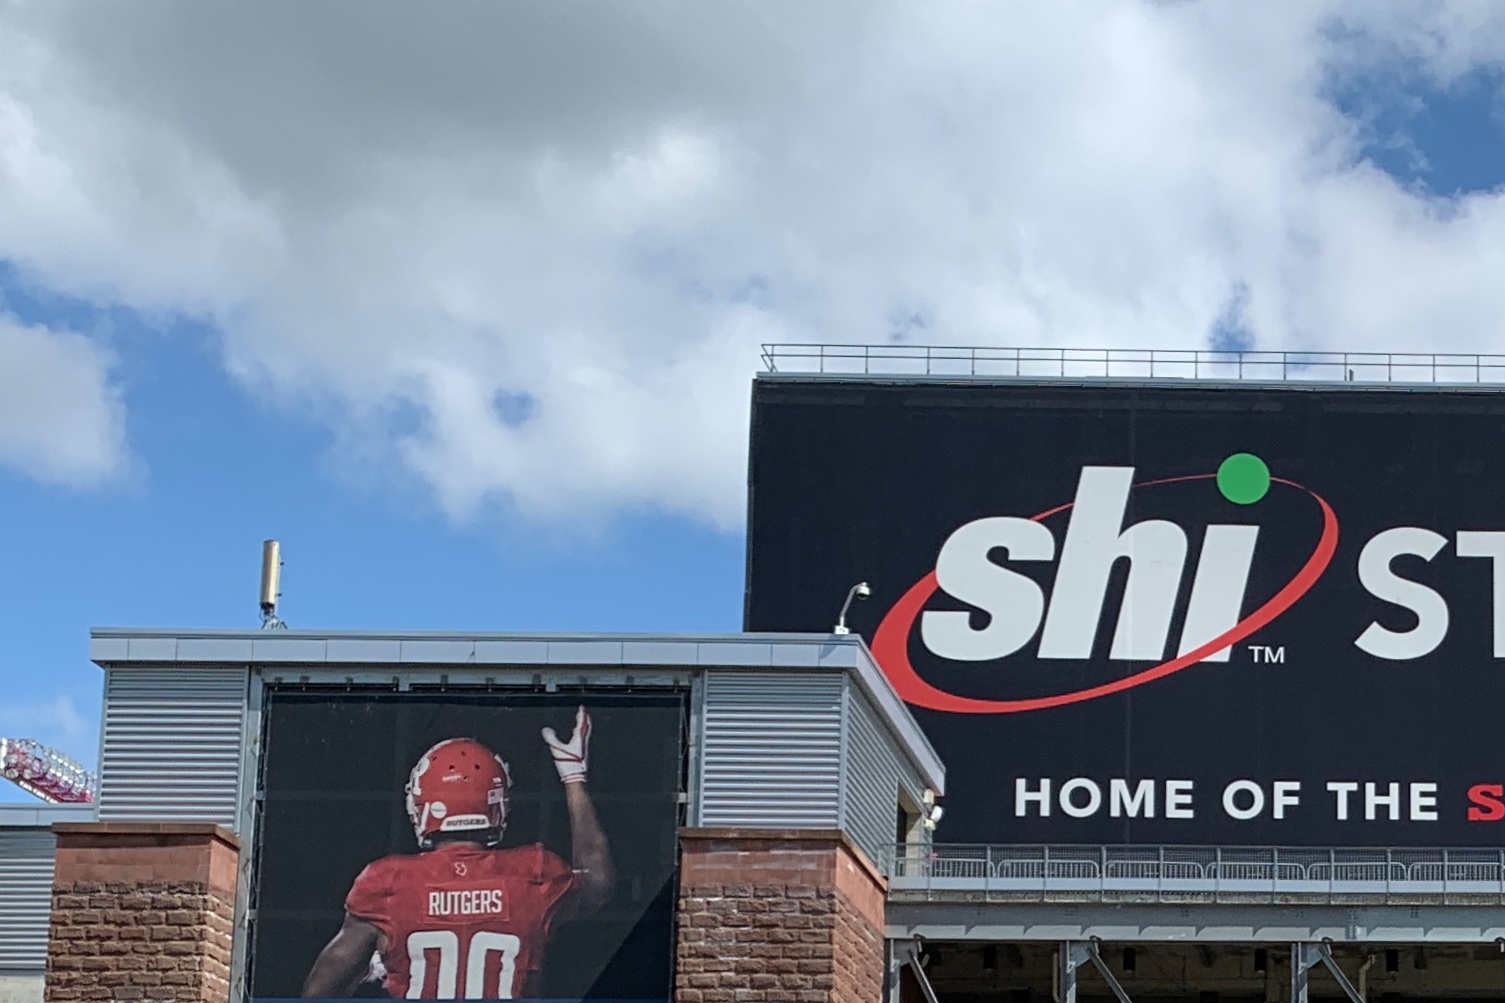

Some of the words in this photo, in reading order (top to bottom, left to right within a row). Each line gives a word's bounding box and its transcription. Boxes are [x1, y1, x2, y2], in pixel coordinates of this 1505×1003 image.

[921, 452, 1270, 662] shi
[1015, 778, 1194, 818] HOME
[1222, 780, 1300, 820] OF
[1327, 782, 1438, 821] THE
[446, 817, 487, 827] RUTGERS
[429, 890, 502, 916] RUTGERS
